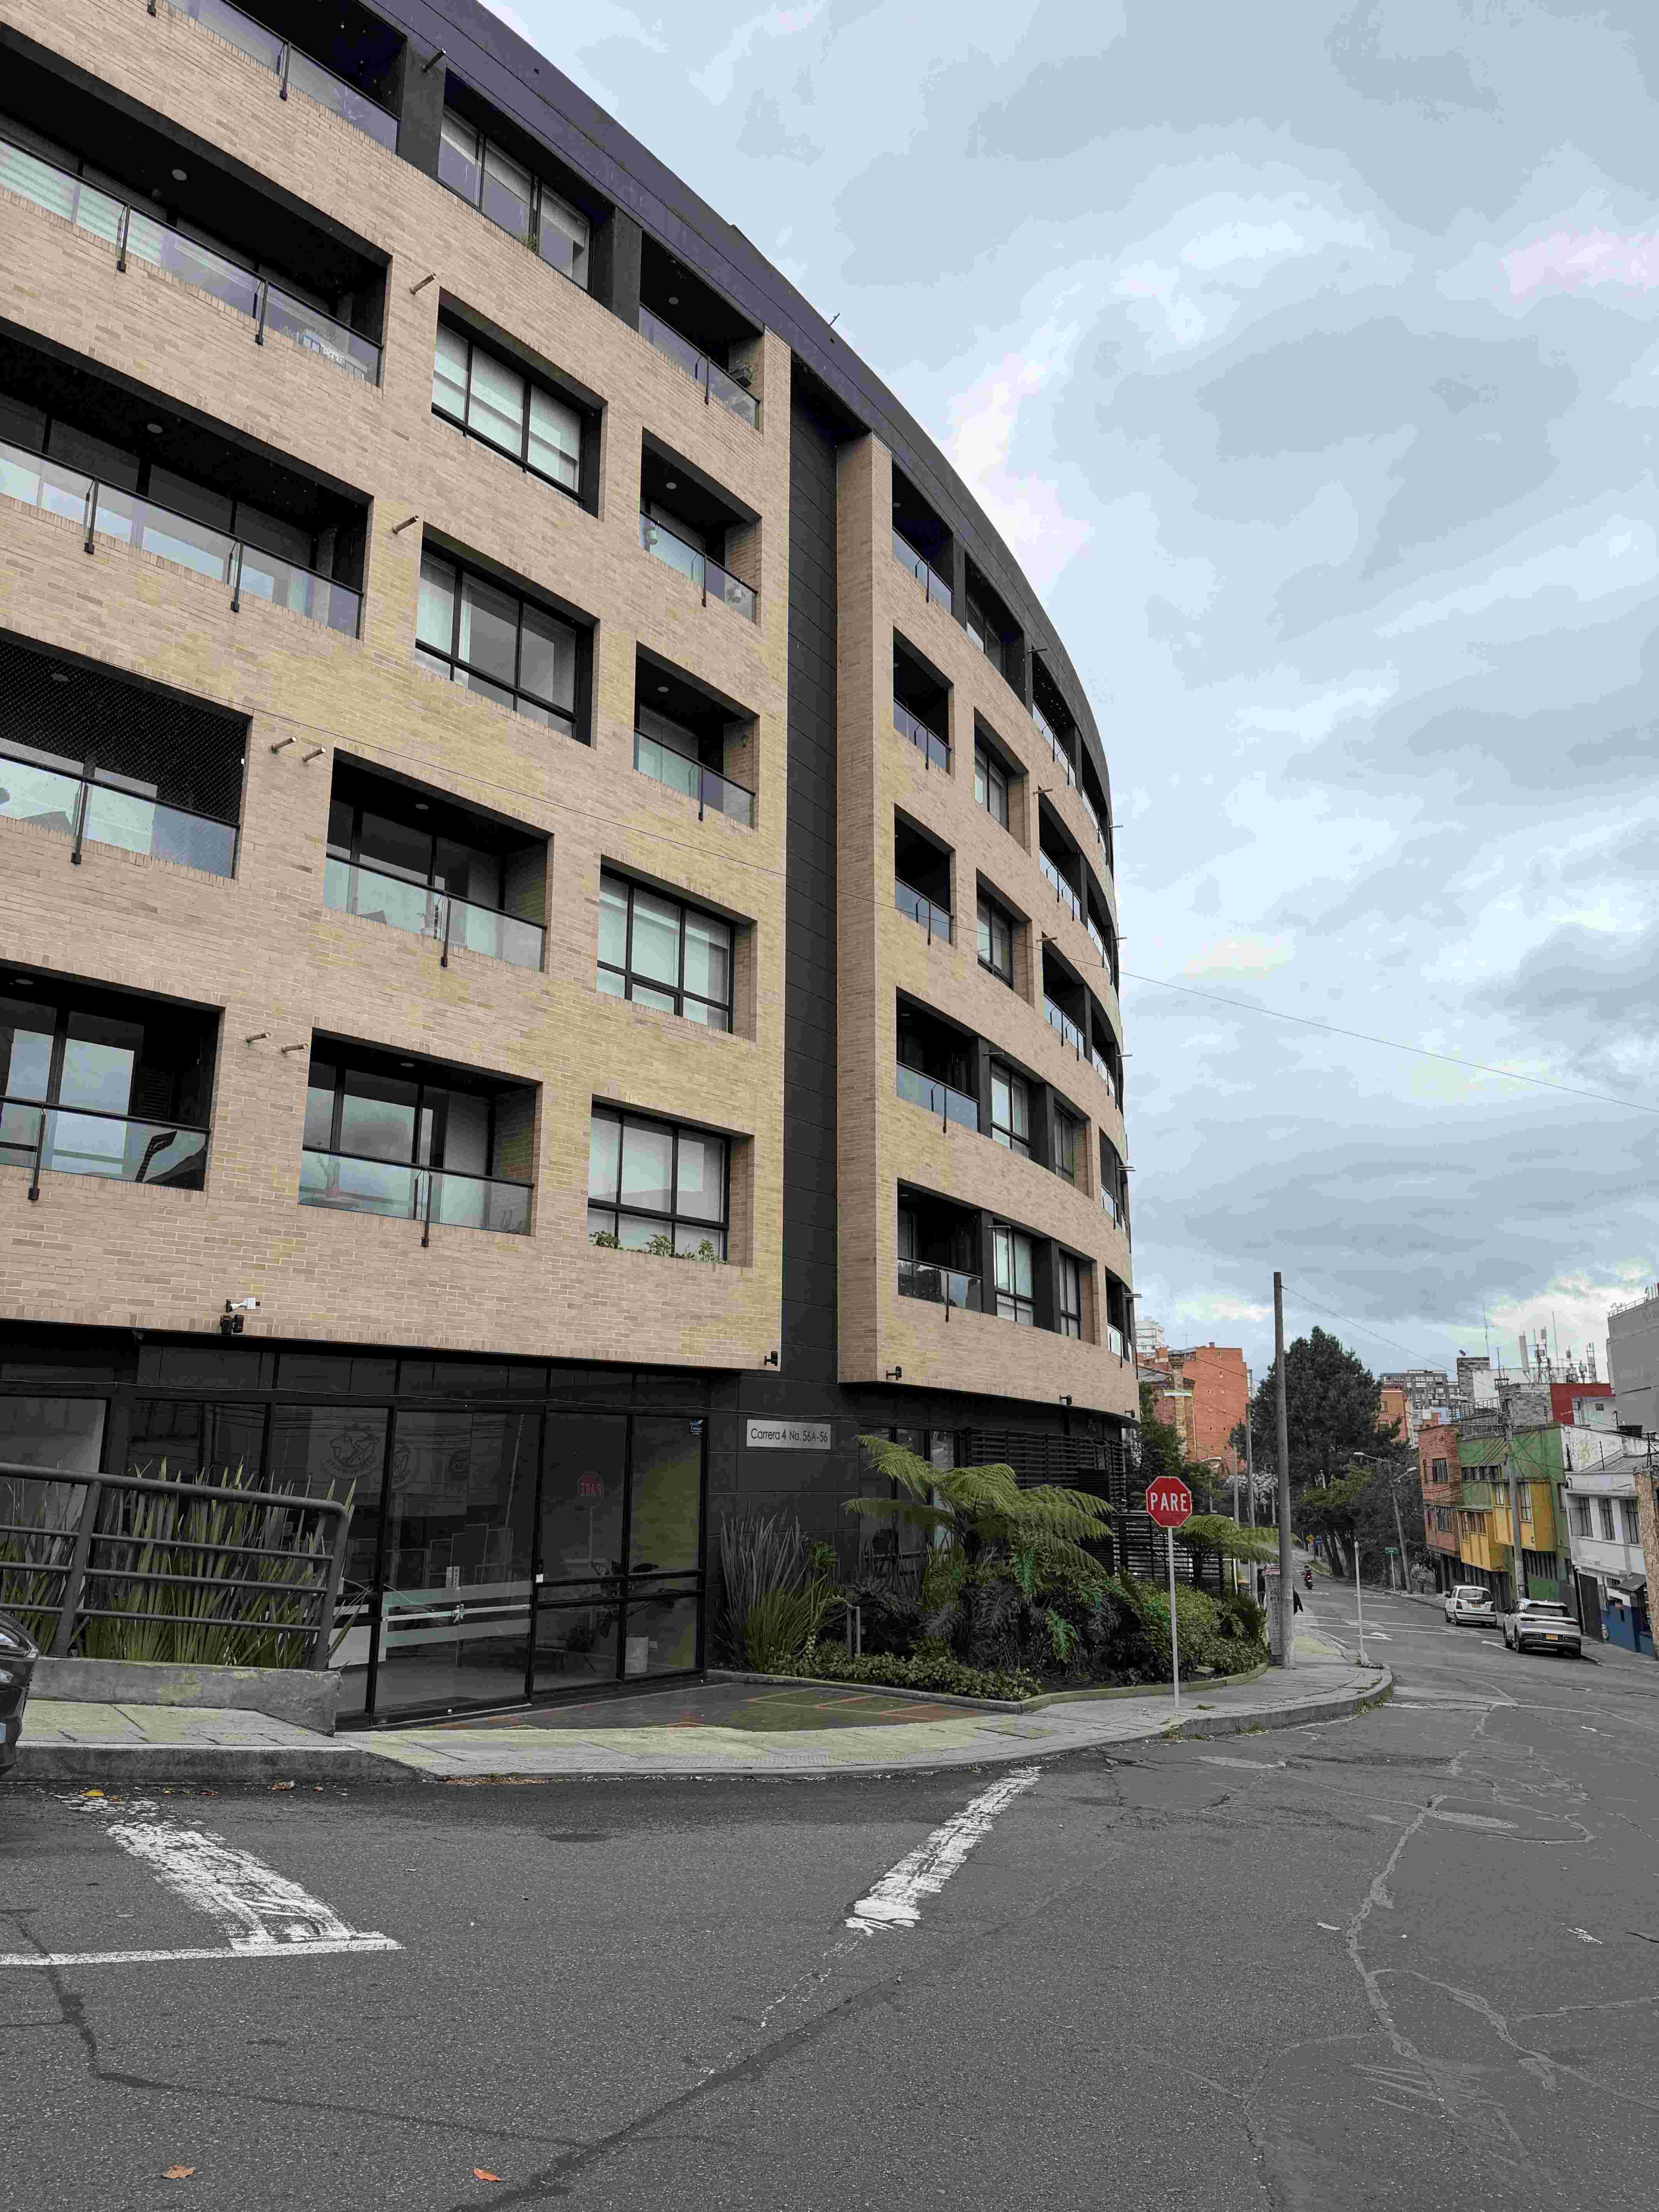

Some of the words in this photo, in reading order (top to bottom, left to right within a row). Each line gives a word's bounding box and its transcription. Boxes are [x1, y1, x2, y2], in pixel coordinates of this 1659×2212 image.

[751, 1428, 780, 1440] Carrera
[781, 1429, 787, 1440] 4
[790, 1430, 801, 1441] No.
[803, 1430, 828, 1443] 56A-56
[1150, 1492, 1188, 1512] PARE
